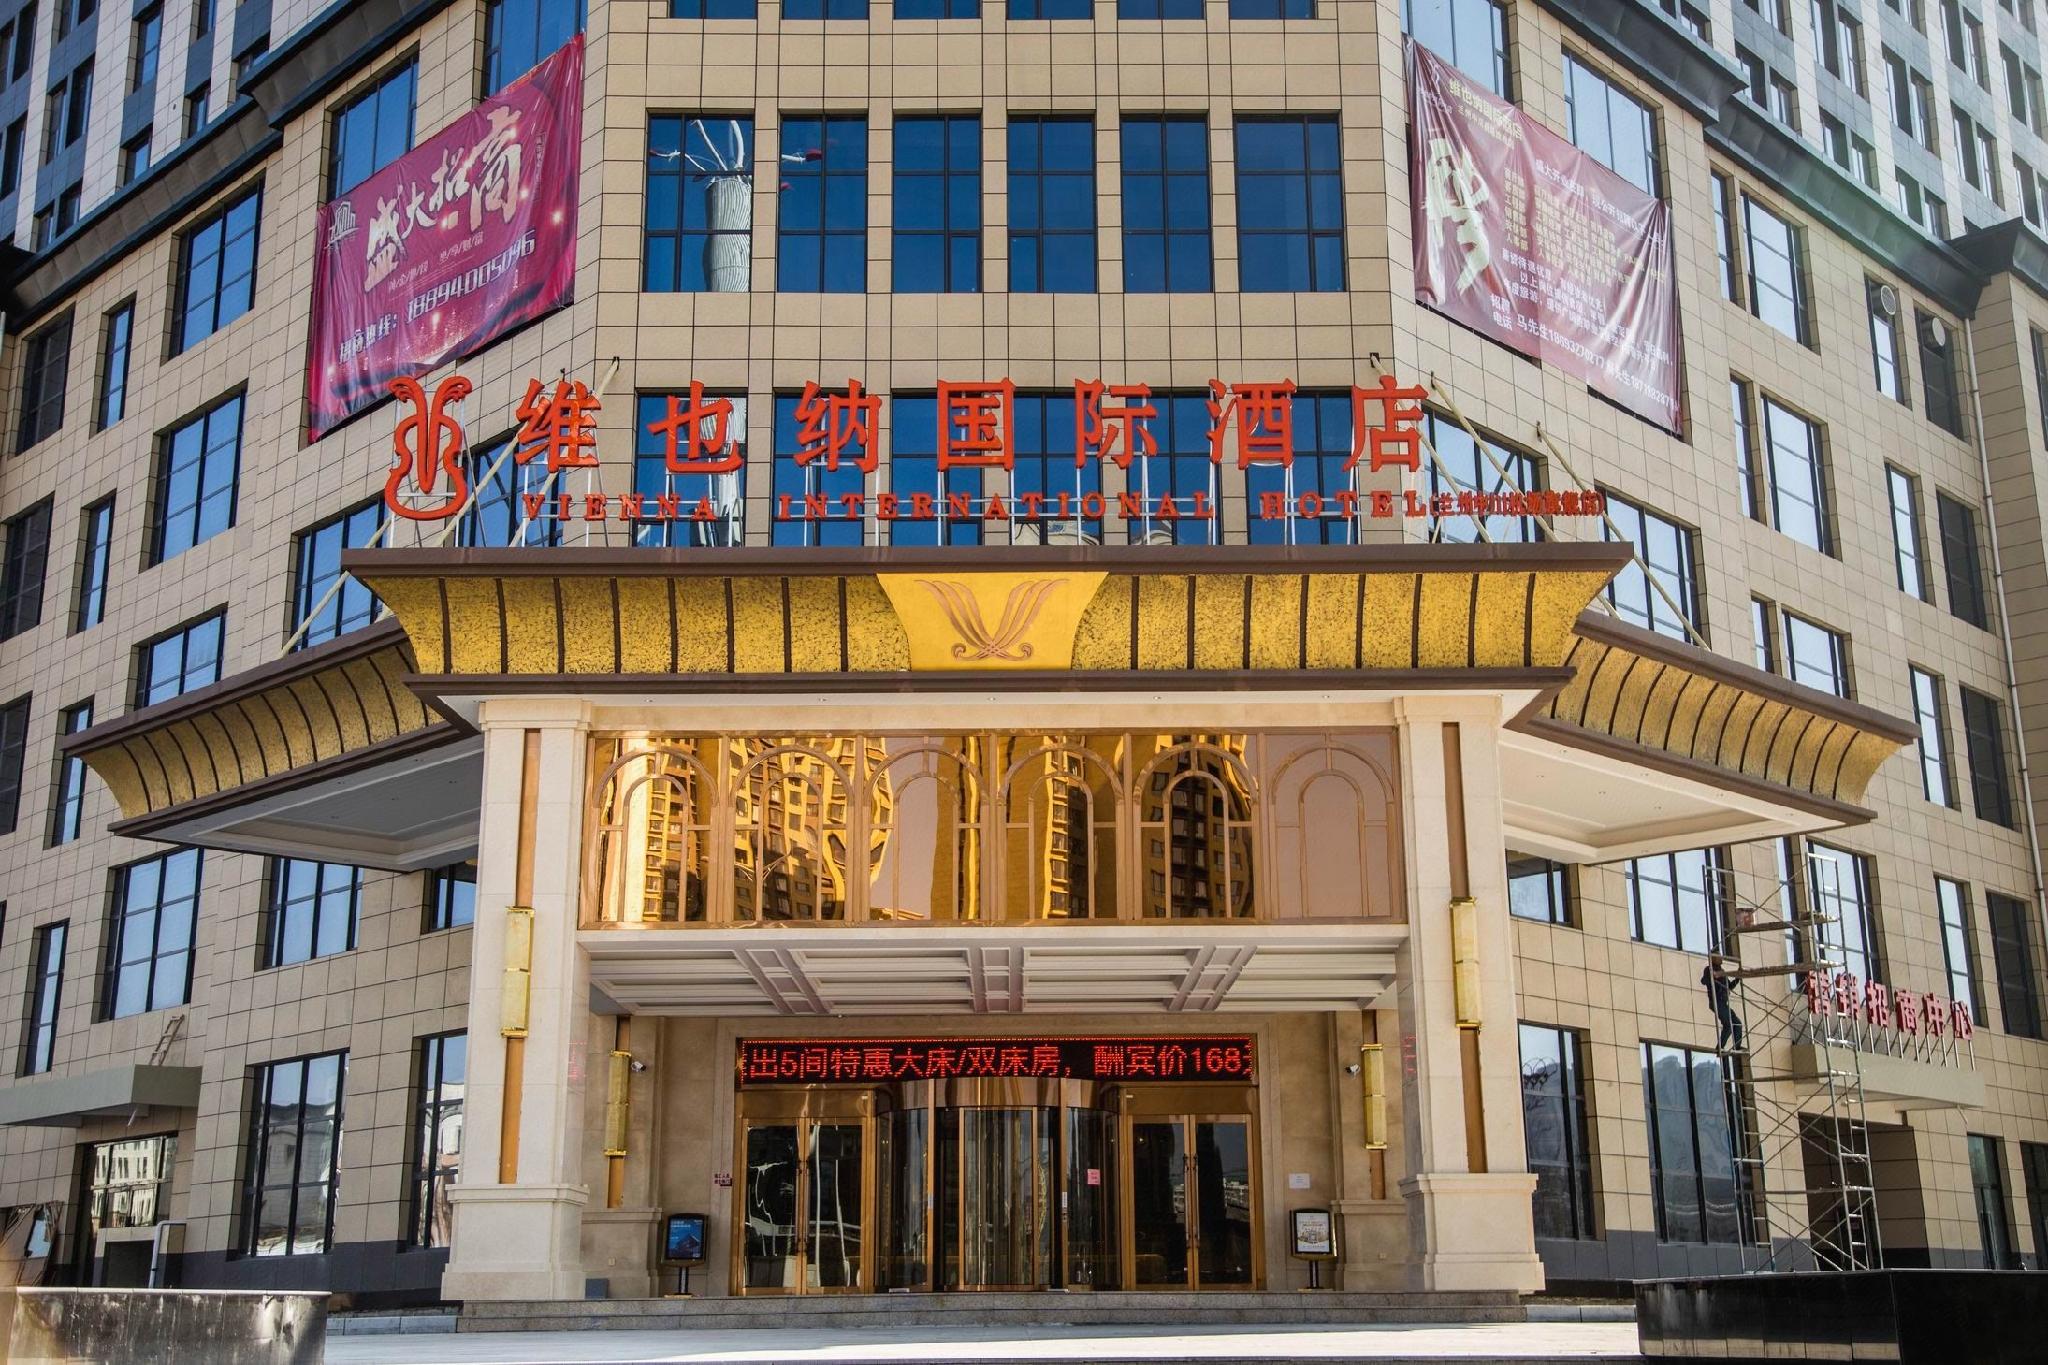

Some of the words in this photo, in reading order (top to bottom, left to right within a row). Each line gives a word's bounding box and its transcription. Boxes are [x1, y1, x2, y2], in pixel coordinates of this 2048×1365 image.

[364, 104, 523, 293] 盛大招商
[406, 230, 536, 323] 18894005096
[1492, 312, 1514, 332] 电话
[515, 376, 1429, 475] 维也纳国际酒店
[523, 493, 717, 522] VIENNA
[779, 490, 1216, 521] INTERNATIONAL
[1262, 490, 1428, 521] HOTEL
[743, 1045, 1252, 1078] 出5间特惠大床/双床房，酬宾价168
